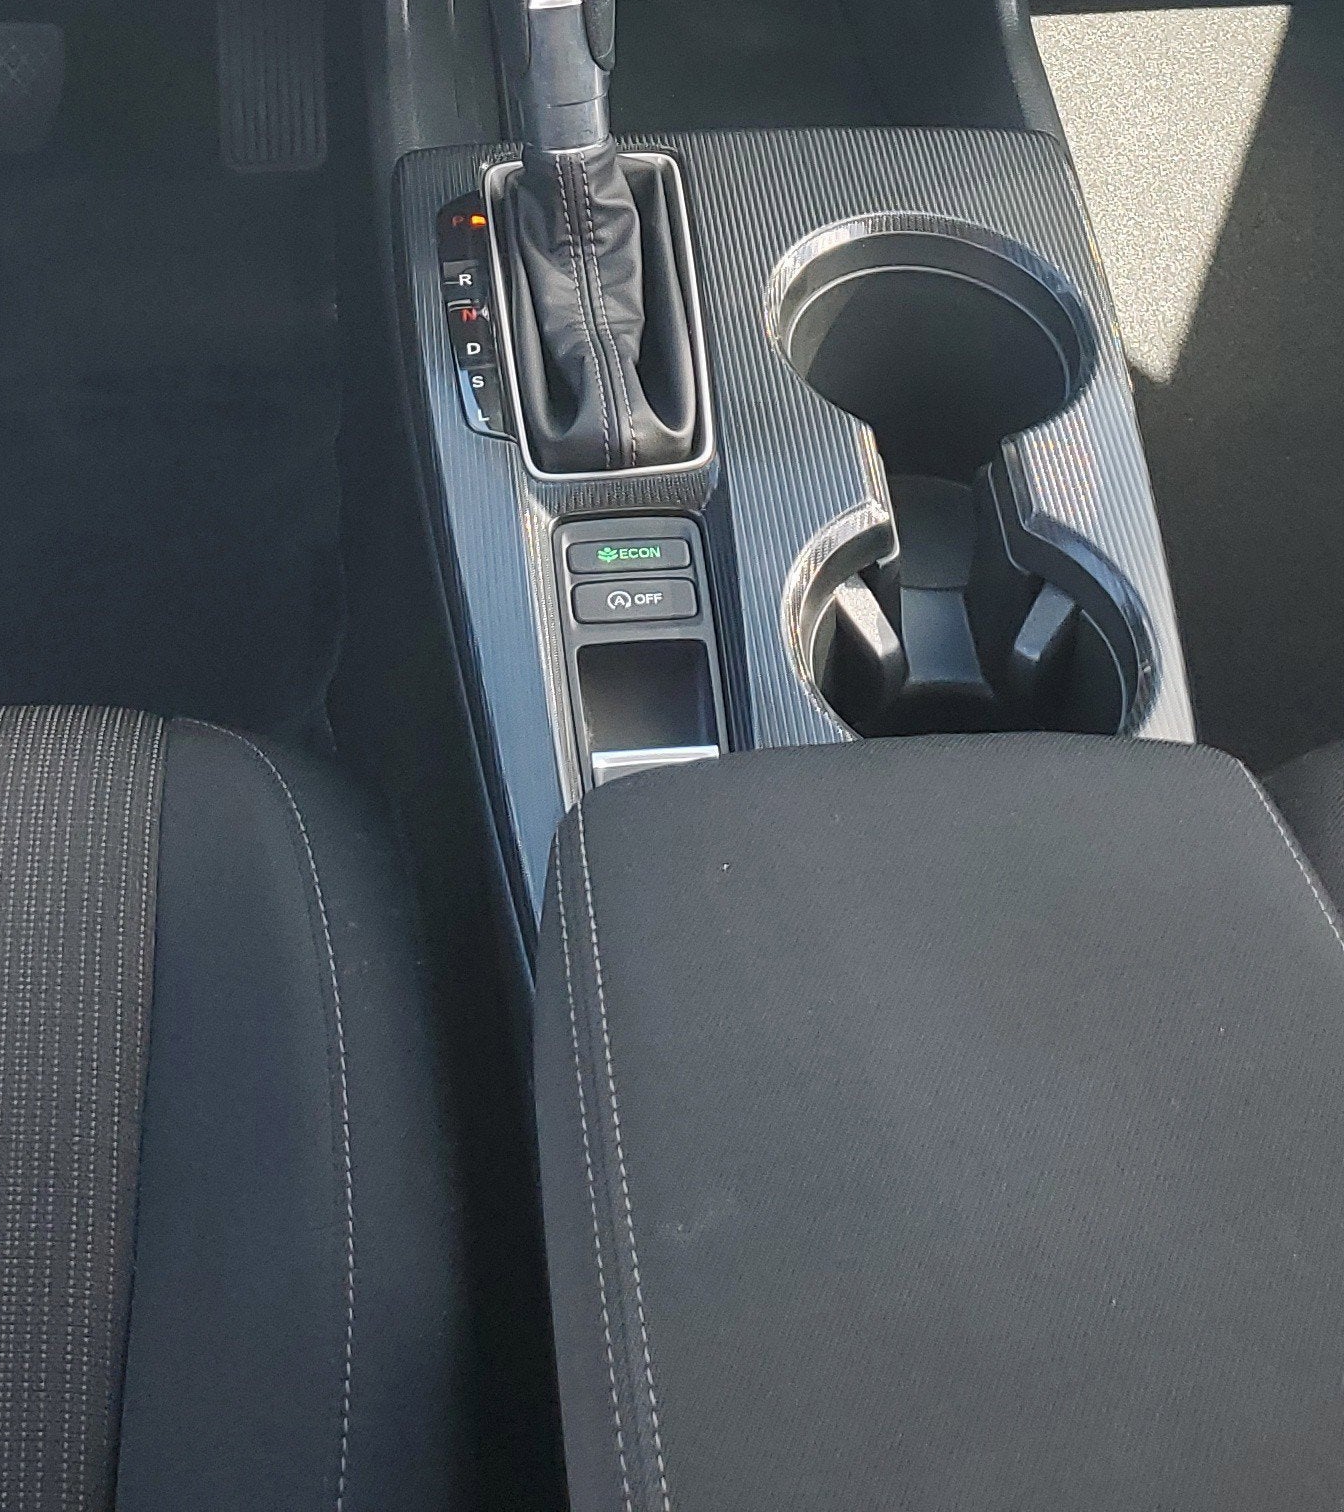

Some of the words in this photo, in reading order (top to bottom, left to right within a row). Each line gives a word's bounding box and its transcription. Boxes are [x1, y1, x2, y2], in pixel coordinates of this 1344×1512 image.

[459, 274, 472, 286] R
[461, 308, 477, 322] N
[467, 342, 481, 355] D
[472, 375, 484, 388] S
[478, 409, 490, 422] L
[619, 547, 661, 560] ECON
[634, 593, 663, 605] OFF
